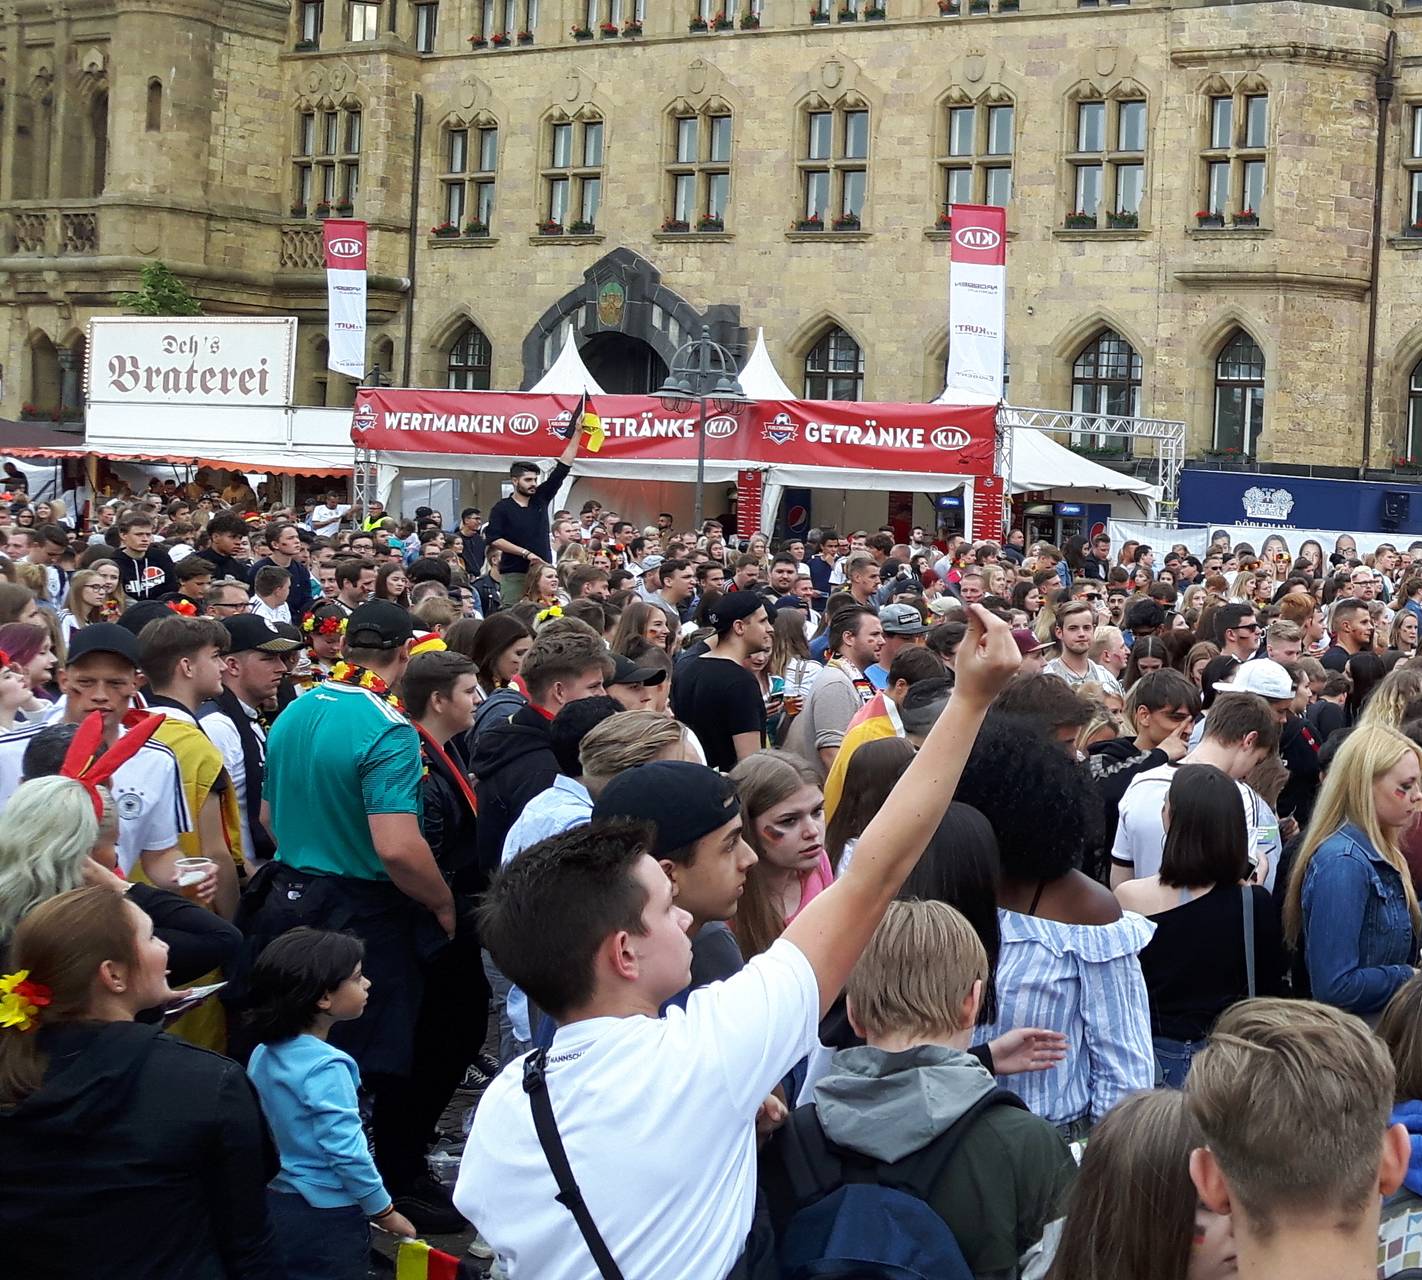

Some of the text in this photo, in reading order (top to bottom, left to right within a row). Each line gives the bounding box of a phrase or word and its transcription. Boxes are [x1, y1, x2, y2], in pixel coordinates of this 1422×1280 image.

[108, 355, 269, 396] Braterei
[384, 411, 505, 434] WERTMARKEN
[513, 417, 534, 431] KIA
[601, 412, 732, 438] ETRÄNKE KIA
[804, 419, 925, 449] GETRÄNKE
[936, 433, 963, 446] KIA
[550, 1052, 585, 1064] MANNSCH
